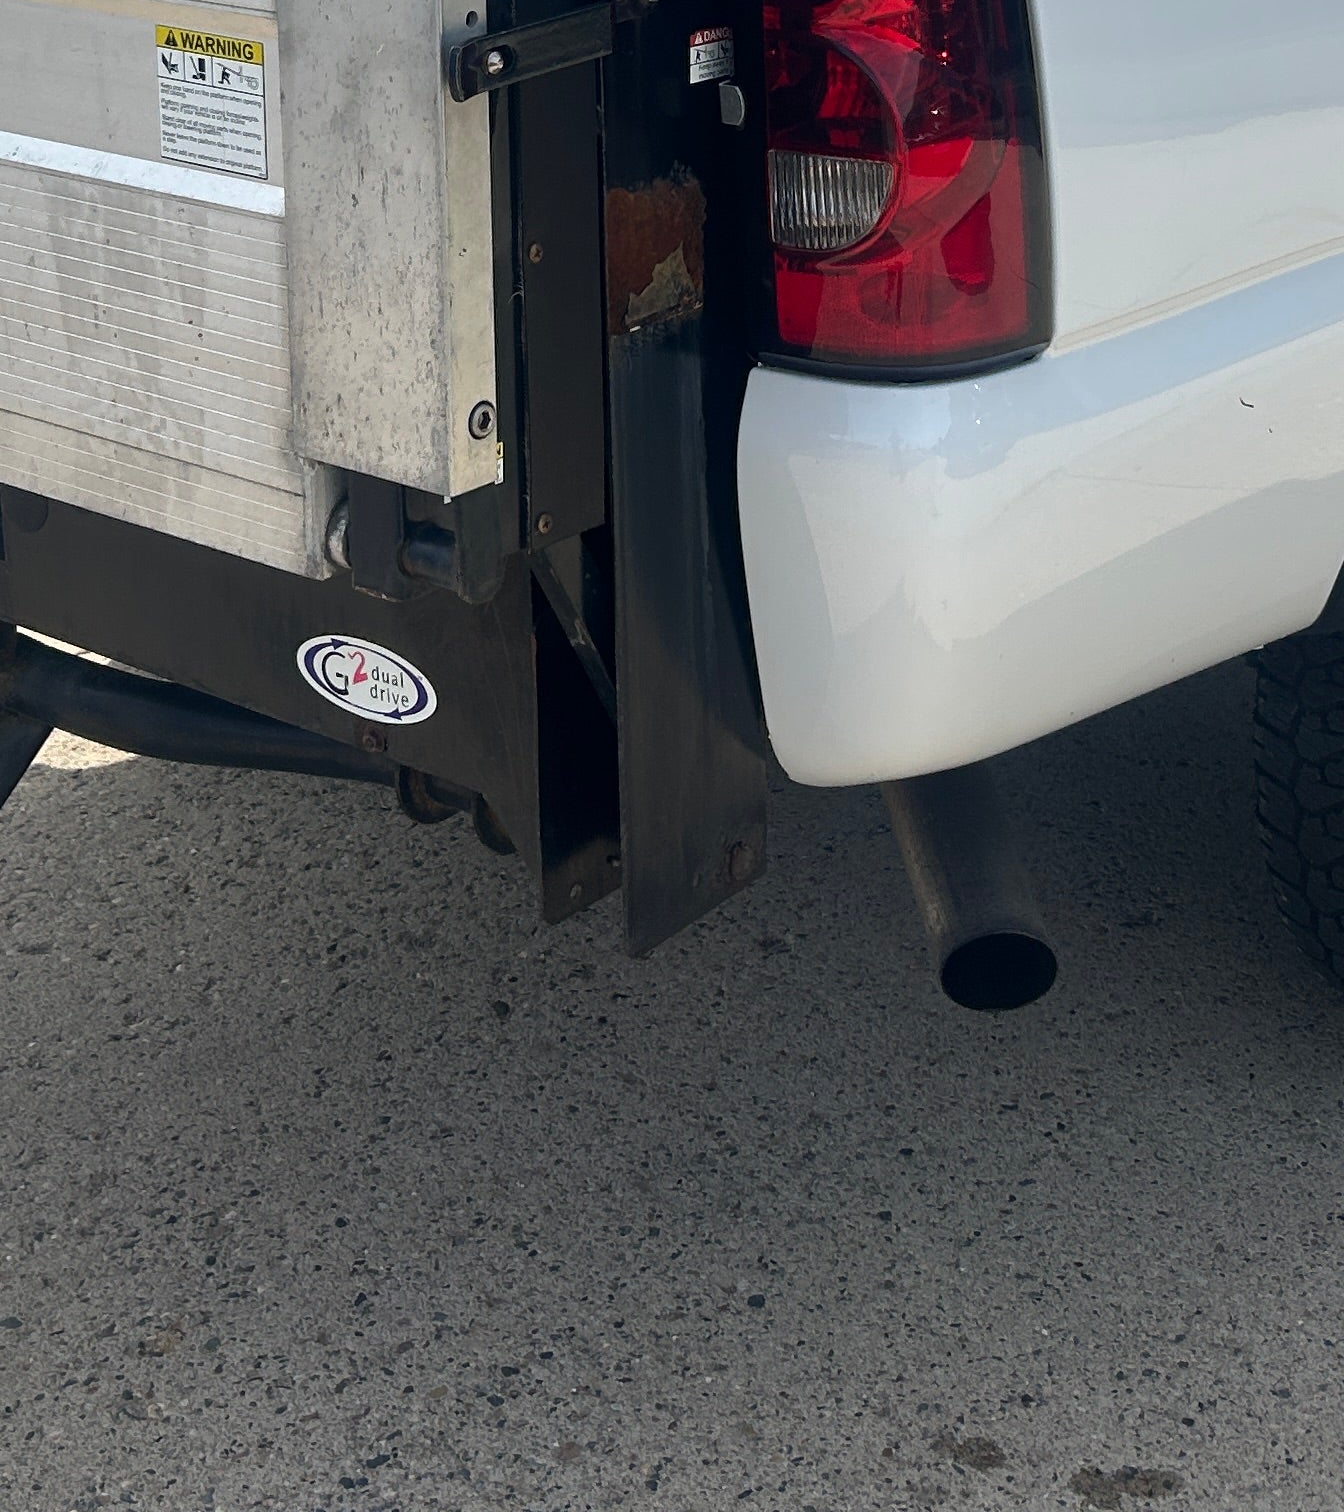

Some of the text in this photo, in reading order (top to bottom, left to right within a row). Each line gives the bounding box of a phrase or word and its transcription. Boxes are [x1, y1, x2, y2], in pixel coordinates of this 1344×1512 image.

[181, 32, 254, 60] WARNING
[371, 666, 404, 688] dual
[370, 684, 409, 708] drive
